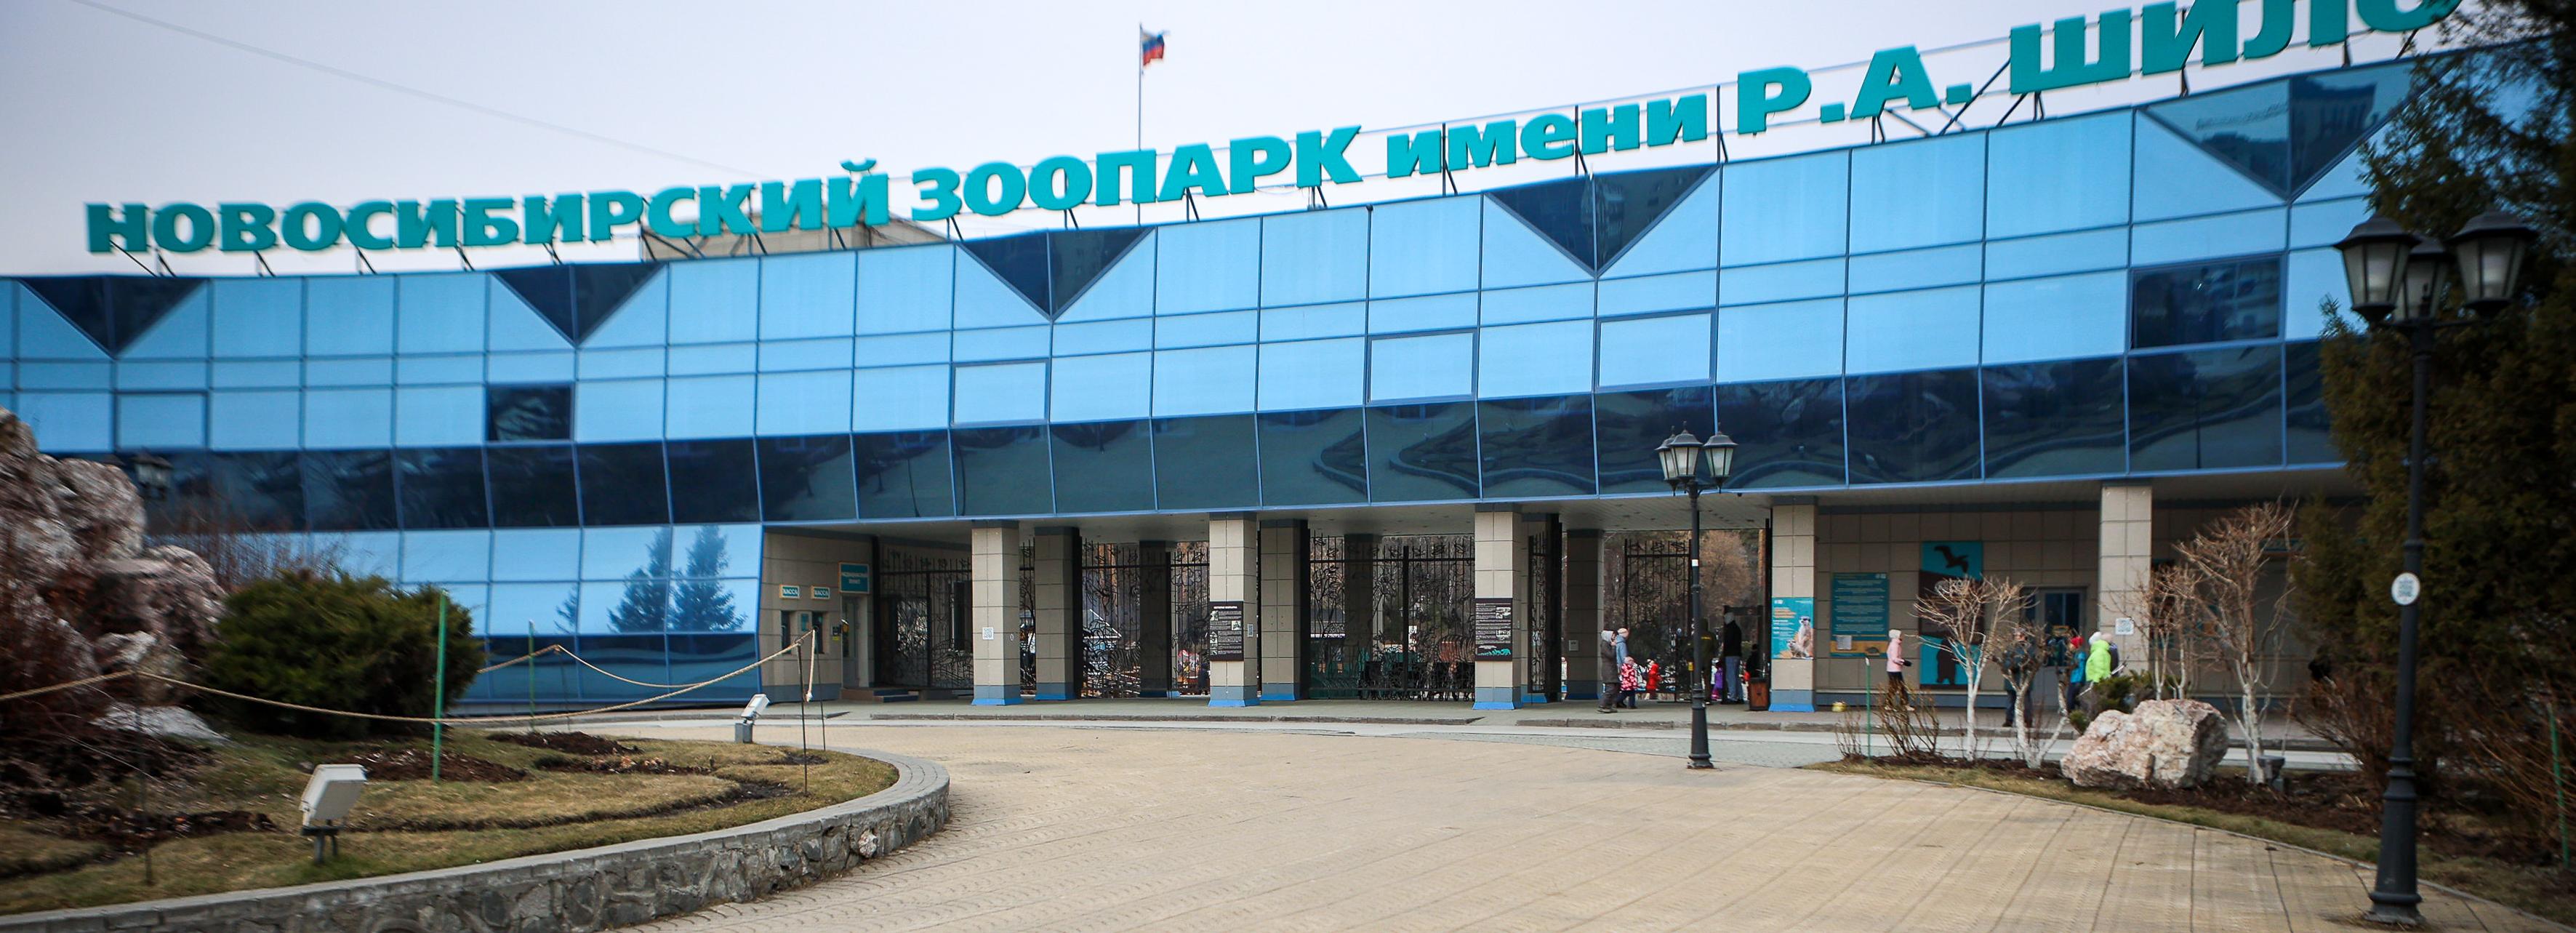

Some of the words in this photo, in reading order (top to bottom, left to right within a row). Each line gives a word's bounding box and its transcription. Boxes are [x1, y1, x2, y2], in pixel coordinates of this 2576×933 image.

[85, 159, 892, 255] НОВОСИБИРСКИЙ
[911, 126, 1364, 223] ЗООПАРК
[1386, 93, 1709, 179] имени
[1736, 46, 1975, 135] Р.А.
